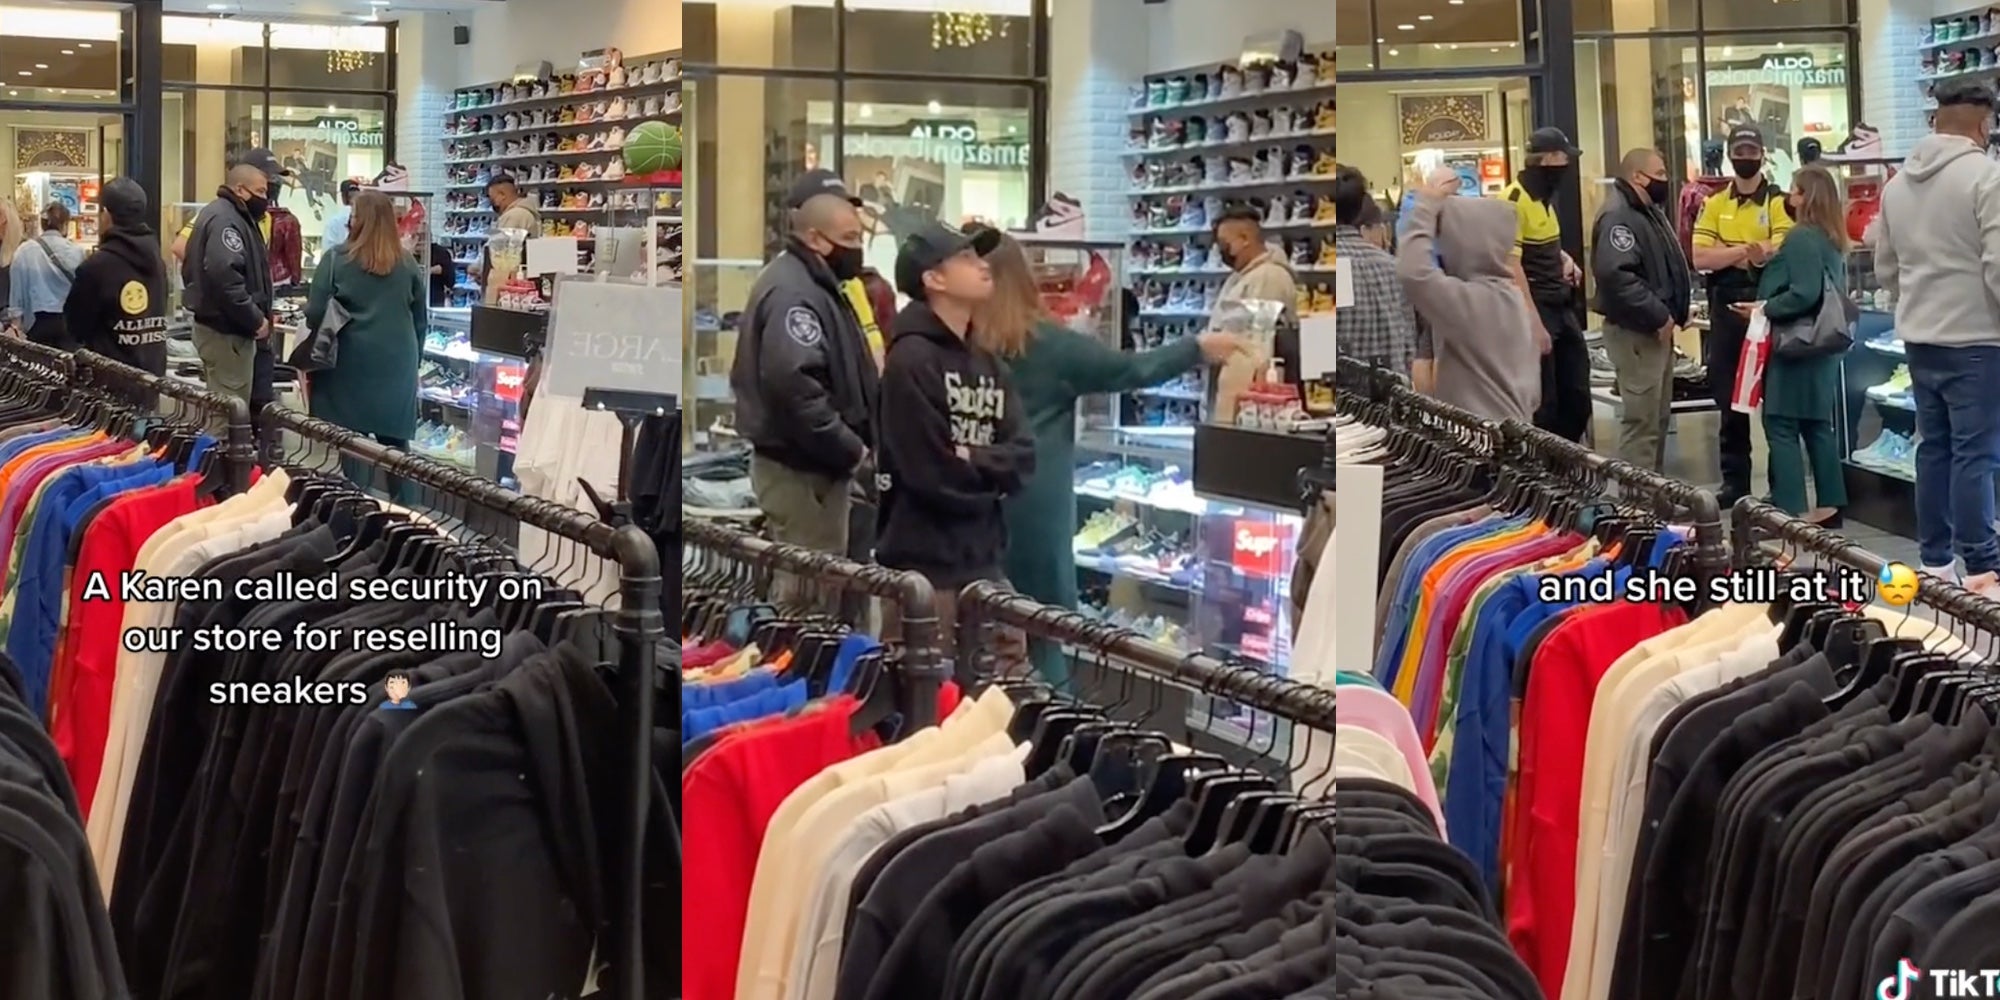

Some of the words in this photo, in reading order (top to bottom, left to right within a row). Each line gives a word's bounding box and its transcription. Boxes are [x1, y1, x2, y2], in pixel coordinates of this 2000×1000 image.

[1763, 57, 1812, 69] ALDO
[317, 120, 357, 131] ALDO
[910, 125, 975, 142] ALDO
[118, 334, 140, 346] NO
